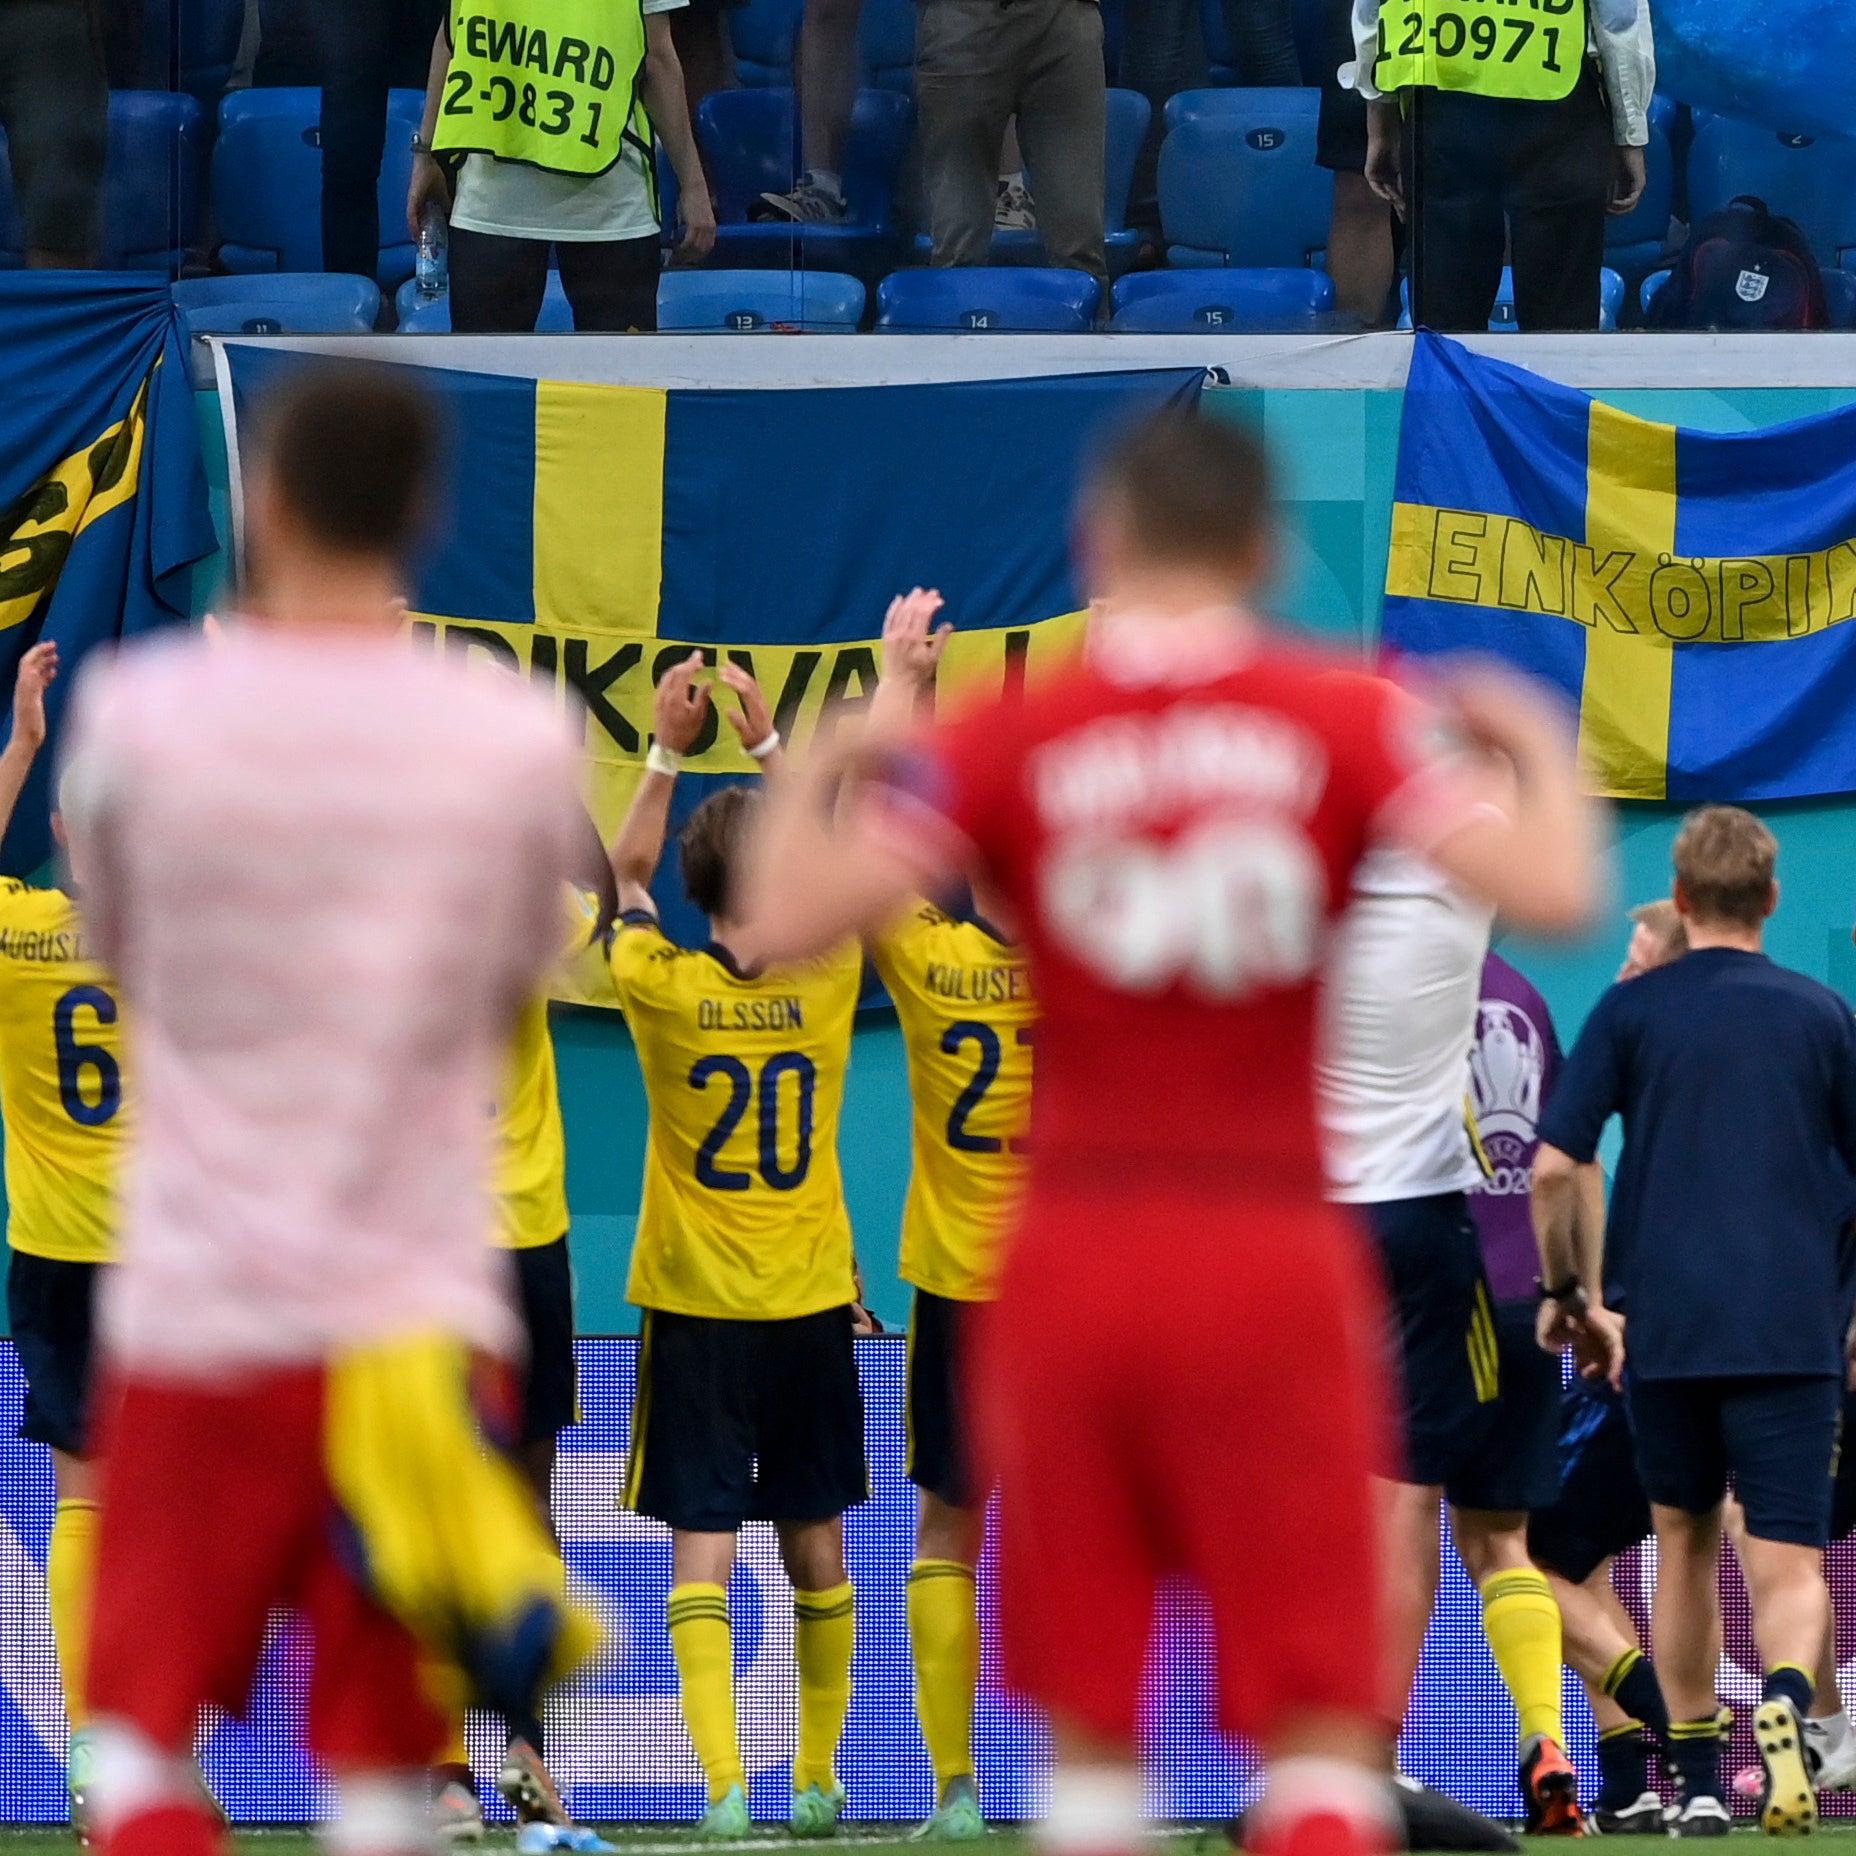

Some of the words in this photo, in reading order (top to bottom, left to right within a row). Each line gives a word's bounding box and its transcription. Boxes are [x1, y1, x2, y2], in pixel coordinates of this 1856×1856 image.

[457, 15, 616, 91] EWARD
[443, 70, 603, 148] 2-0831
[1257, 133, 1274, 148] 15
[736, 315, 753, 330] 13
[970, 315, 987, 329] 14
[1206, 311, 1222, 325] 15
[0, 929, 92, 964] AUGUST
[924, 961, 1028, 1004] KULUSE
[697, 998, 803, 1032] OLSSON
[53, 983, 121, 1127] 6
[687, 1050, 816, 1192] 20
